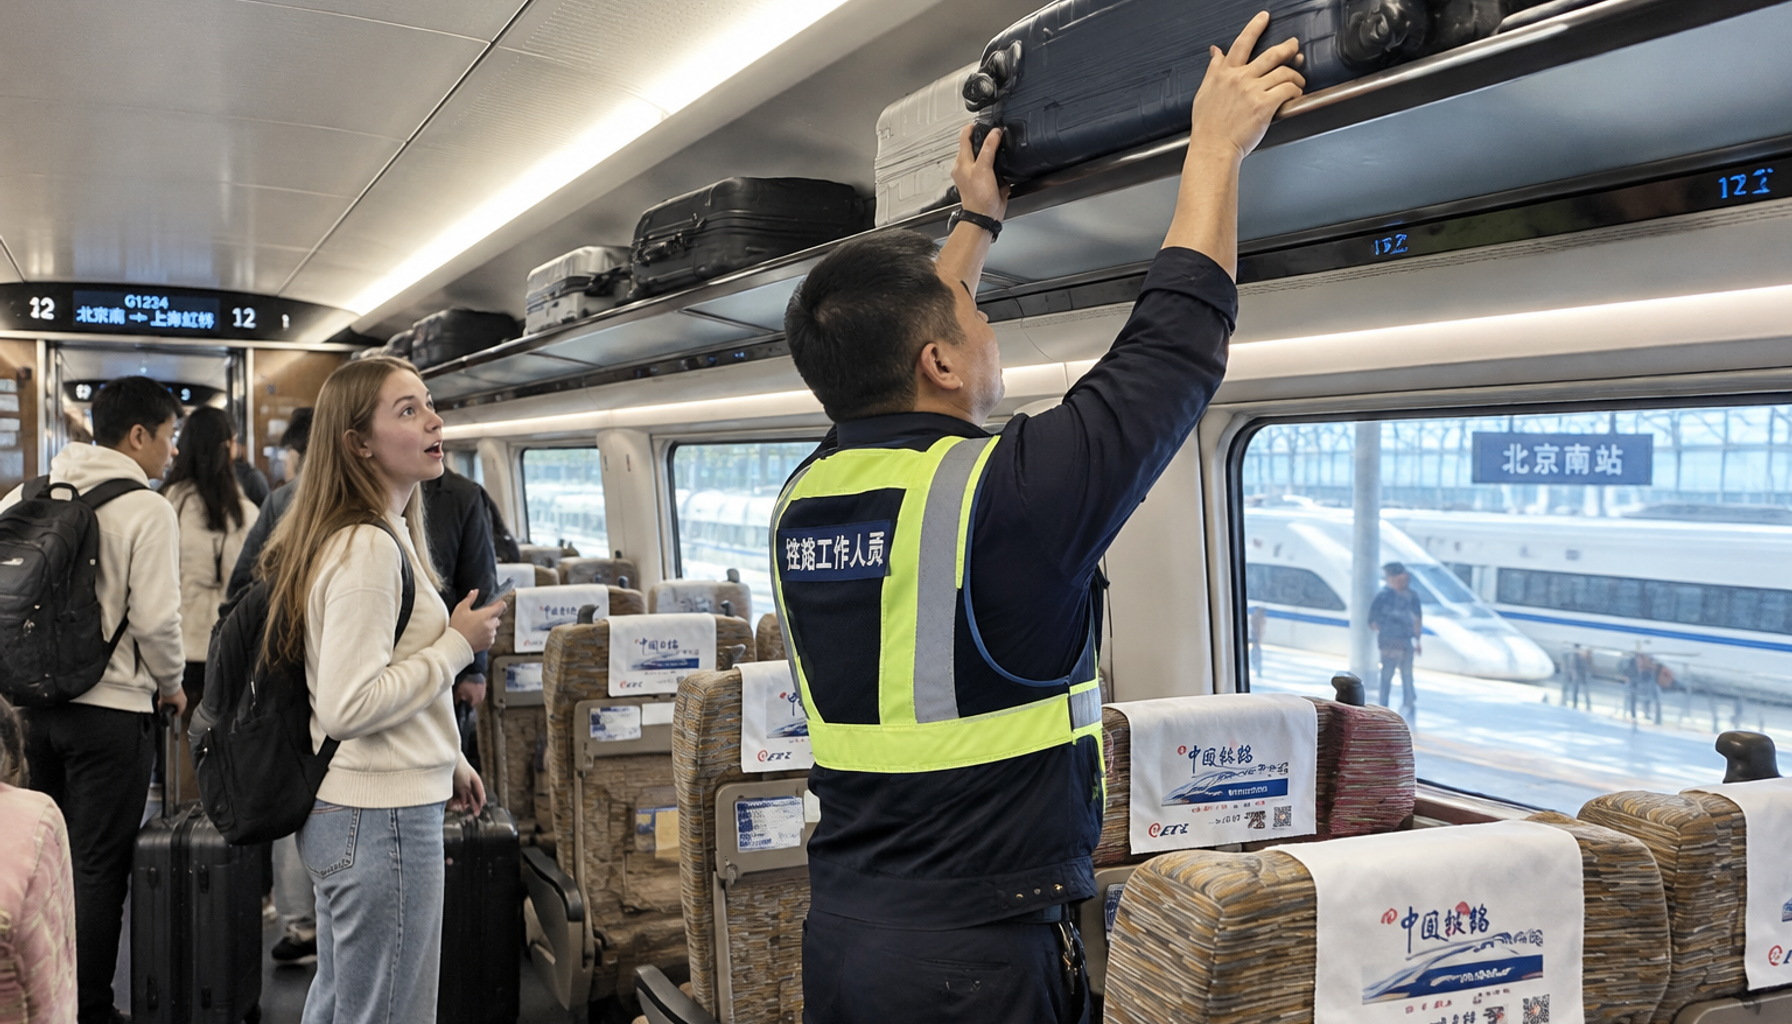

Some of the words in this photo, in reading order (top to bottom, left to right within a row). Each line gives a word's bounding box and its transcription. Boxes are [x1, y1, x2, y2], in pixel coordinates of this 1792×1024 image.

[29, 296, 55, 320] 12
[124, 294, 169, 310] G1234
[76, 305, 126, 325] 北京南
[232, 307, 257, 329] 12
[1502, 442, 1624, 476] 北京南站
